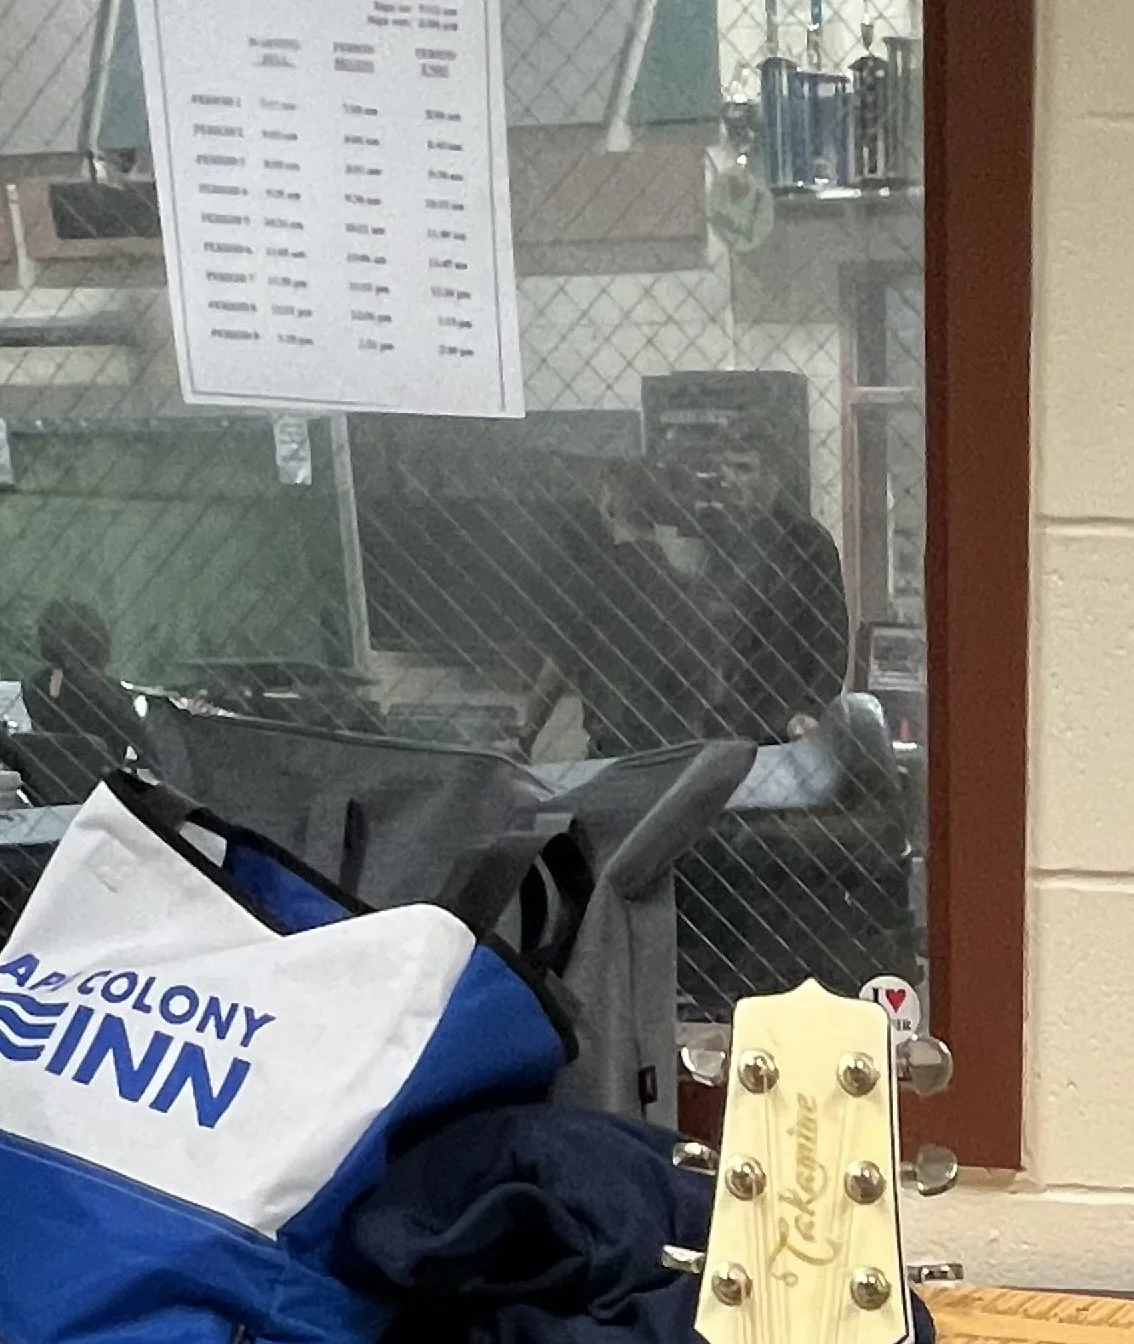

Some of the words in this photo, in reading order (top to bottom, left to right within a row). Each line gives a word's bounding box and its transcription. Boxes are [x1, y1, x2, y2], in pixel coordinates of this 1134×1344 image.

[45, 1004, 252, 1128] INN
[77, 970, 276, 1048] COLONY
[767, 1091, 842, 1288] Takamine
